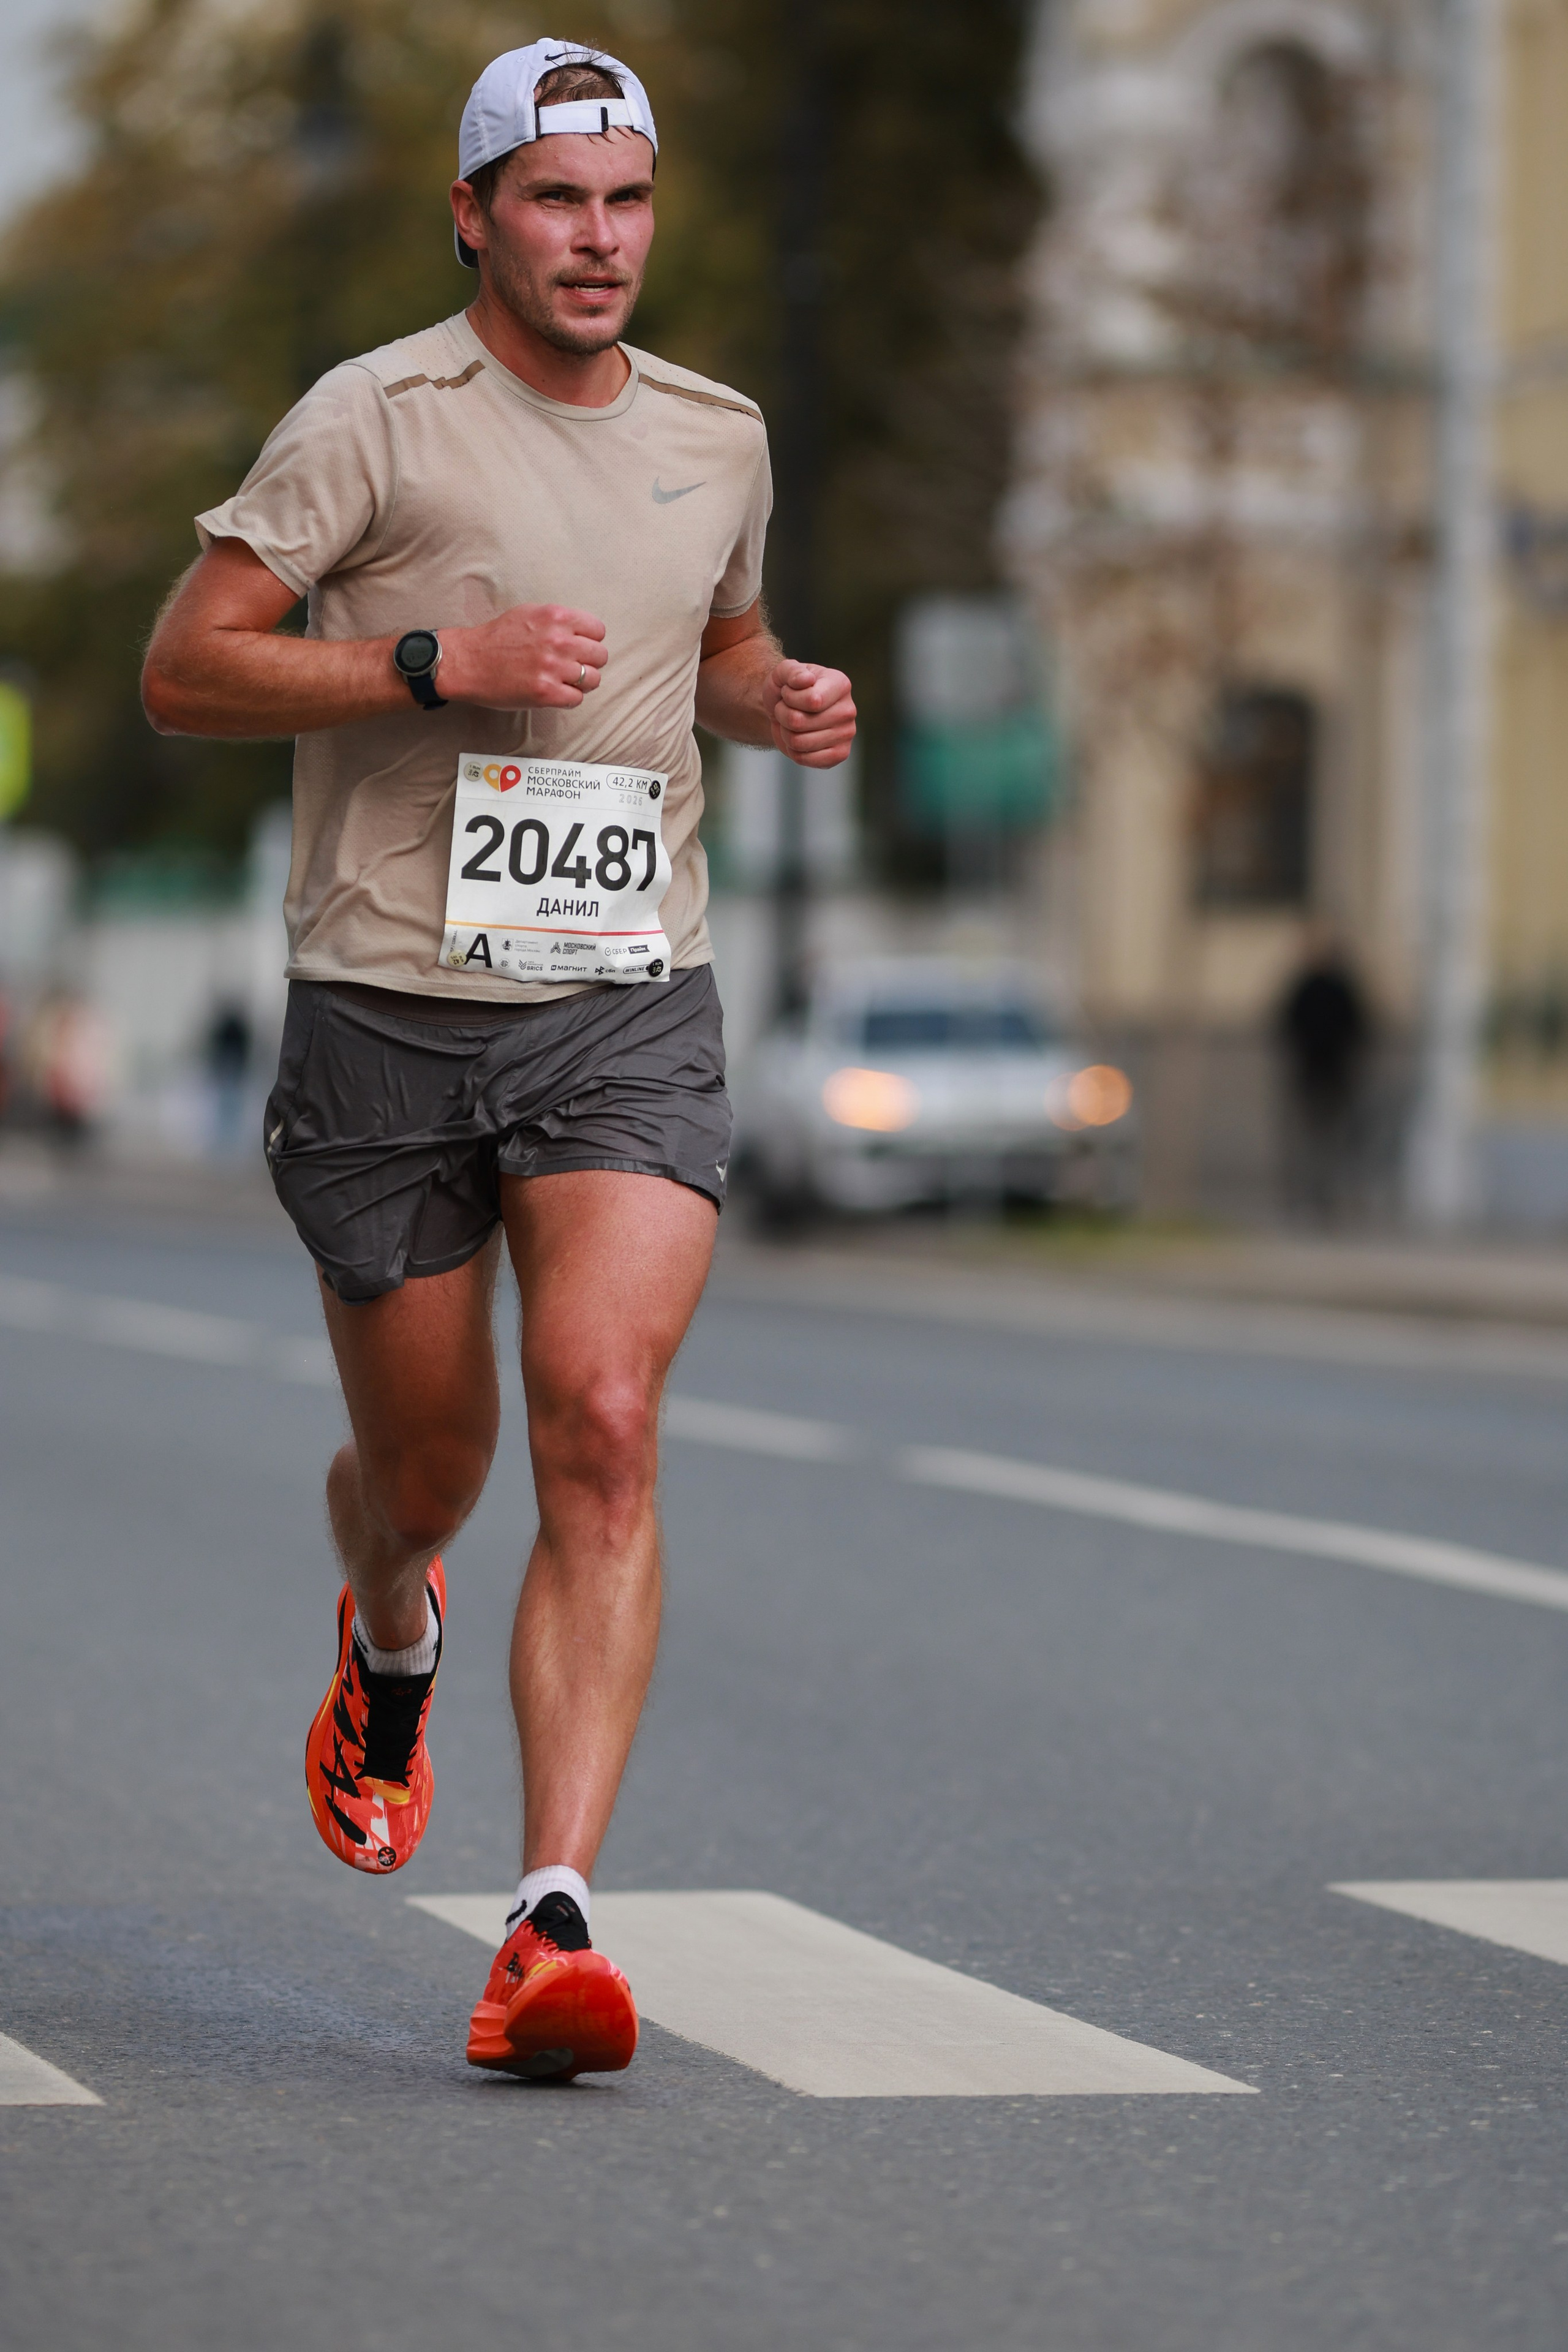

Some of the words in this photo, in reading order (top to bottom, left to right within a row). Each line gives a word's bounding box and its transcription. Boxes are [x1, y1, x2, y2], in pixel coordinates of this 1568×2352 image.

[528, 766, 581, 777] СБЕРПРАЙМ
[527, 776, 600, 790] МОСКОВСКИЙ
[612, 777, 633, 788] 42,2
[526, 786, 581, 799] МАРАФОН
[461, 814, 657, 891] 20487
[536, 897, 599, 918] ДАНИЛ
[564, 942, 597, 951] МОСКОВСКИЙ
